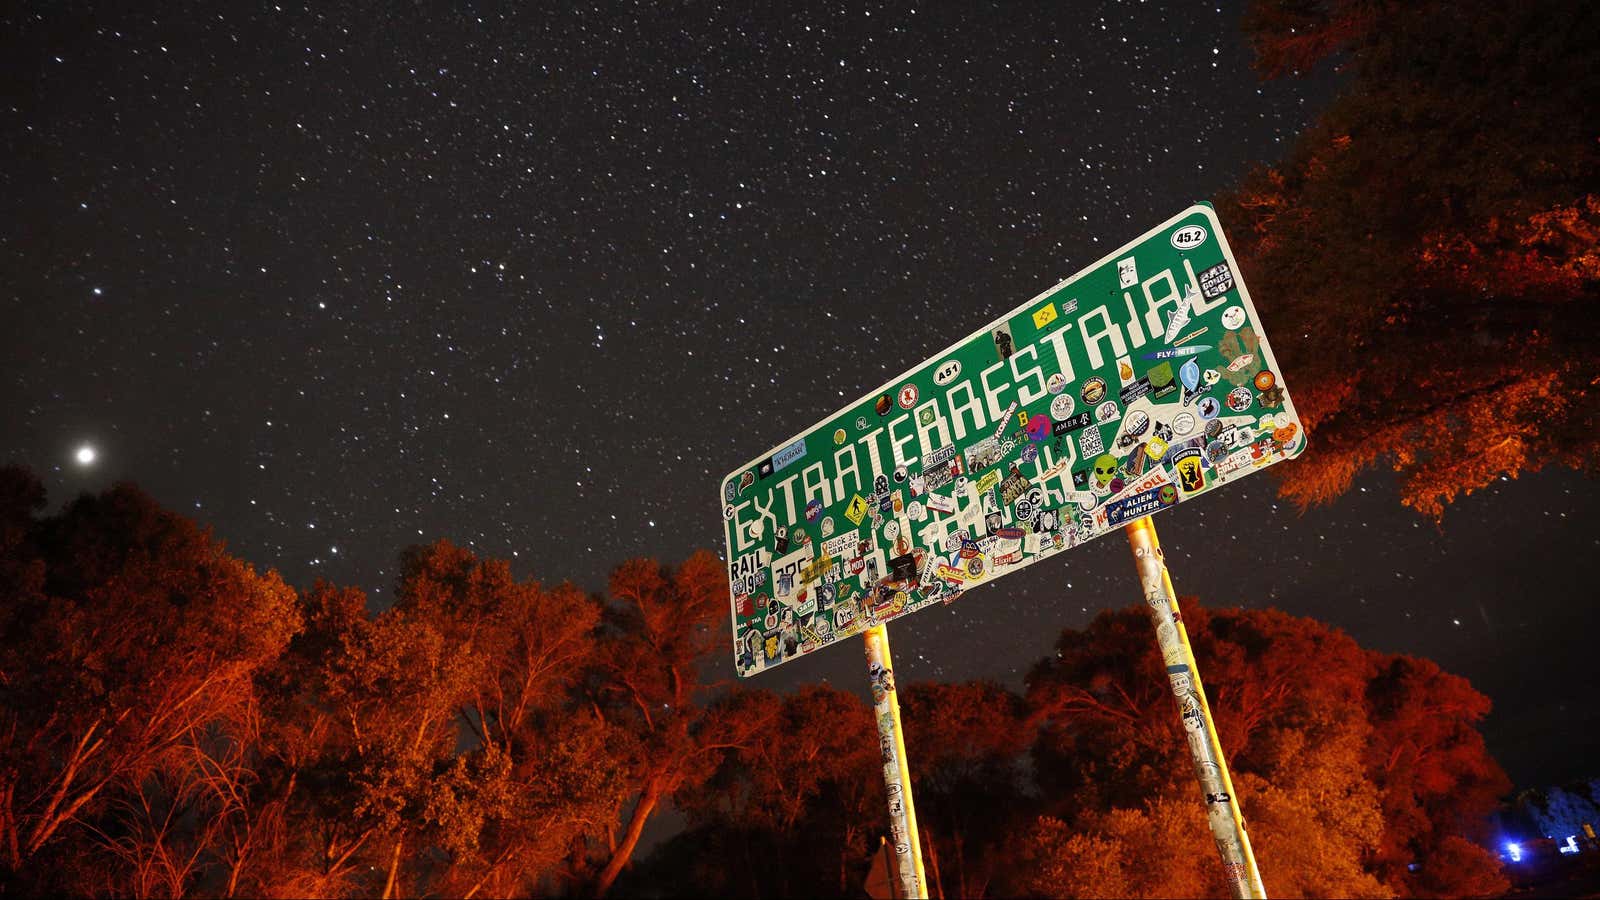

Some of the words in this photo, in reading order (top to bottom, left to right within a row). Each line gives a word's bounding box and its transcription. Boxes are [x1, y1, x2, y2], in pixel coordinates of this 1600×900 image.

[1176, 230, 1201, 243] 45.2
[938, 363, 959, 382] A51
[1018, 411, 1028, 427] B
[1126, 493, 1153, 508] ALIEN
[1123, 500, 1160, 518] HUNTER
[828, 537, 847, 549] Suck
[829, 540, 856, 555] cancer
[731, 551, 763, 580] RAIL
[743, 575, 755, 594] 19
